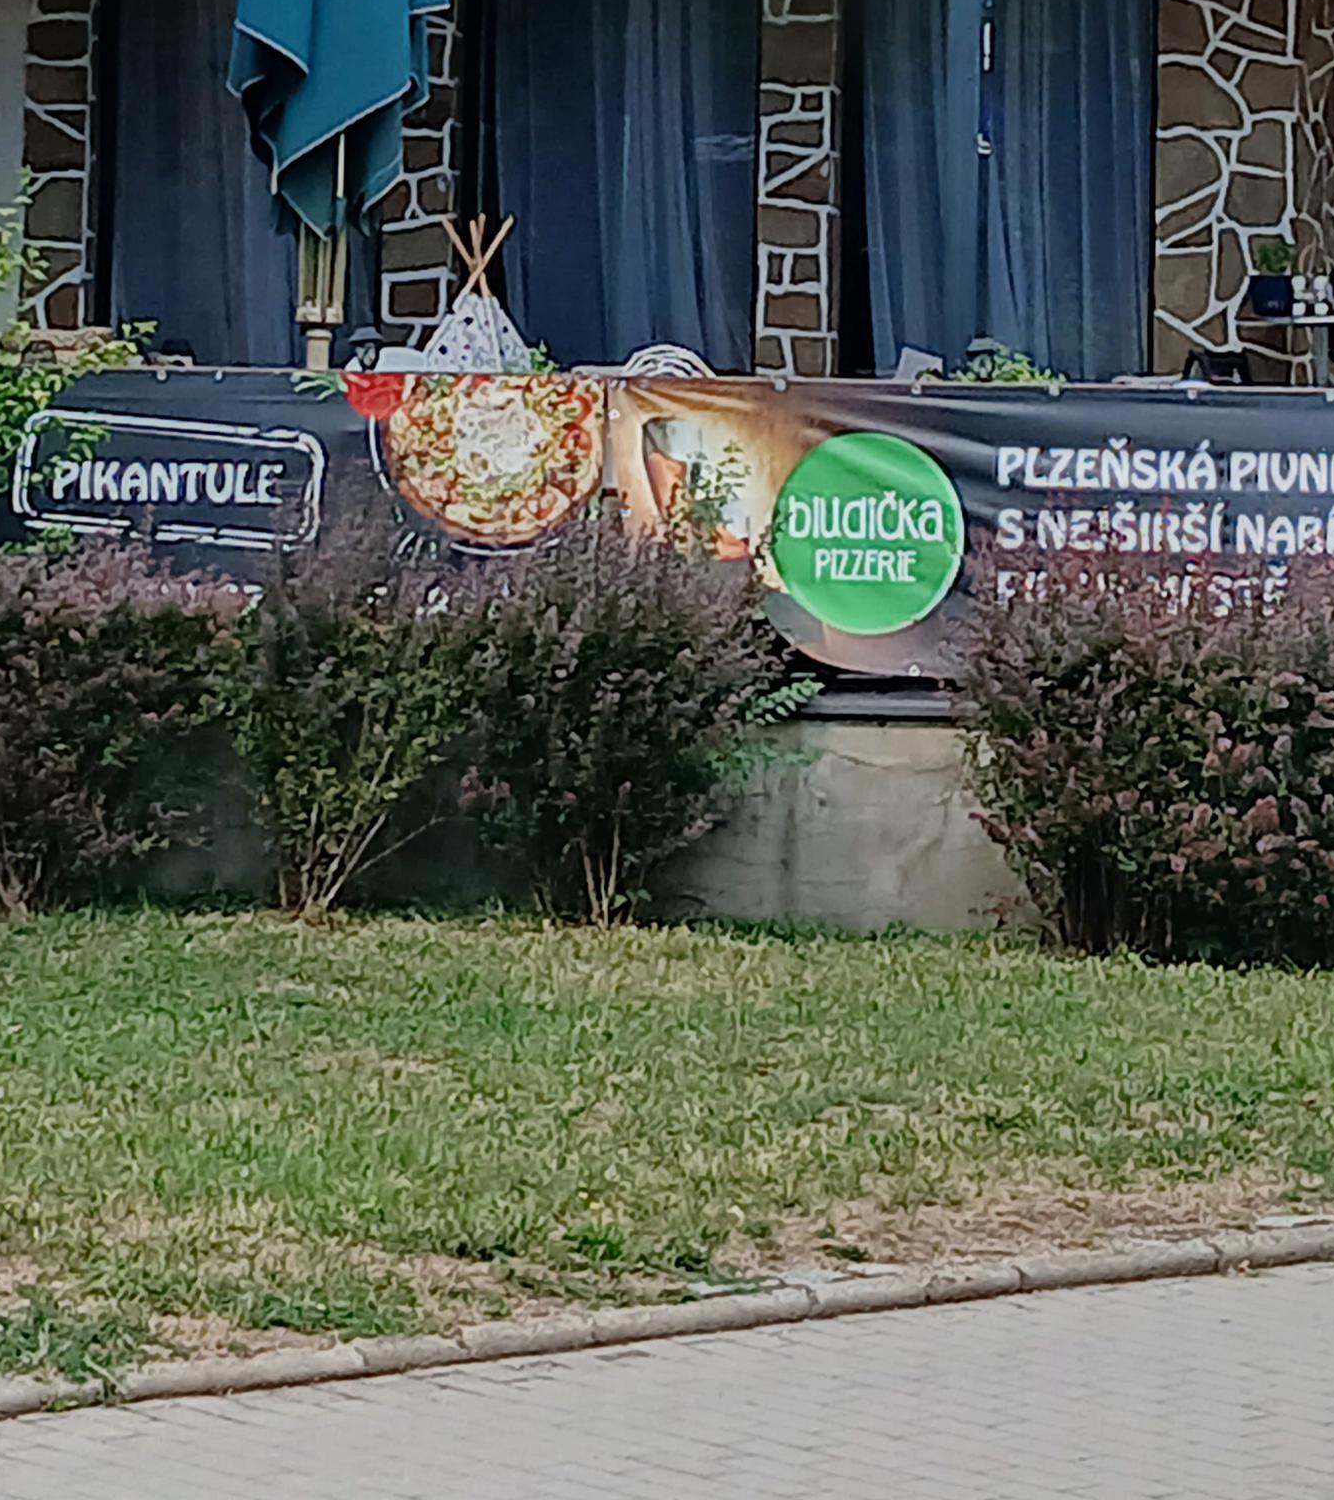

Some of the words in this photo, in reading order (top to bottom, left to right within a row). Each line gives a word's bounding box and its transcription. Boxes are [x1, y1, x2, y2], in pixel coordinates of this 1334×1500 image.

[51, 458, 284, 505] PIKANTULE
[997, 436, 1217, 491] PLZEŇSKÁ
[788, 490, 945, 542] bludička
[997, 508, 1025, 549] S
[1035, 499, 1226, 553] NEJŠIRŠÍ
[814, 547, 917, 582] PIZZERIE
